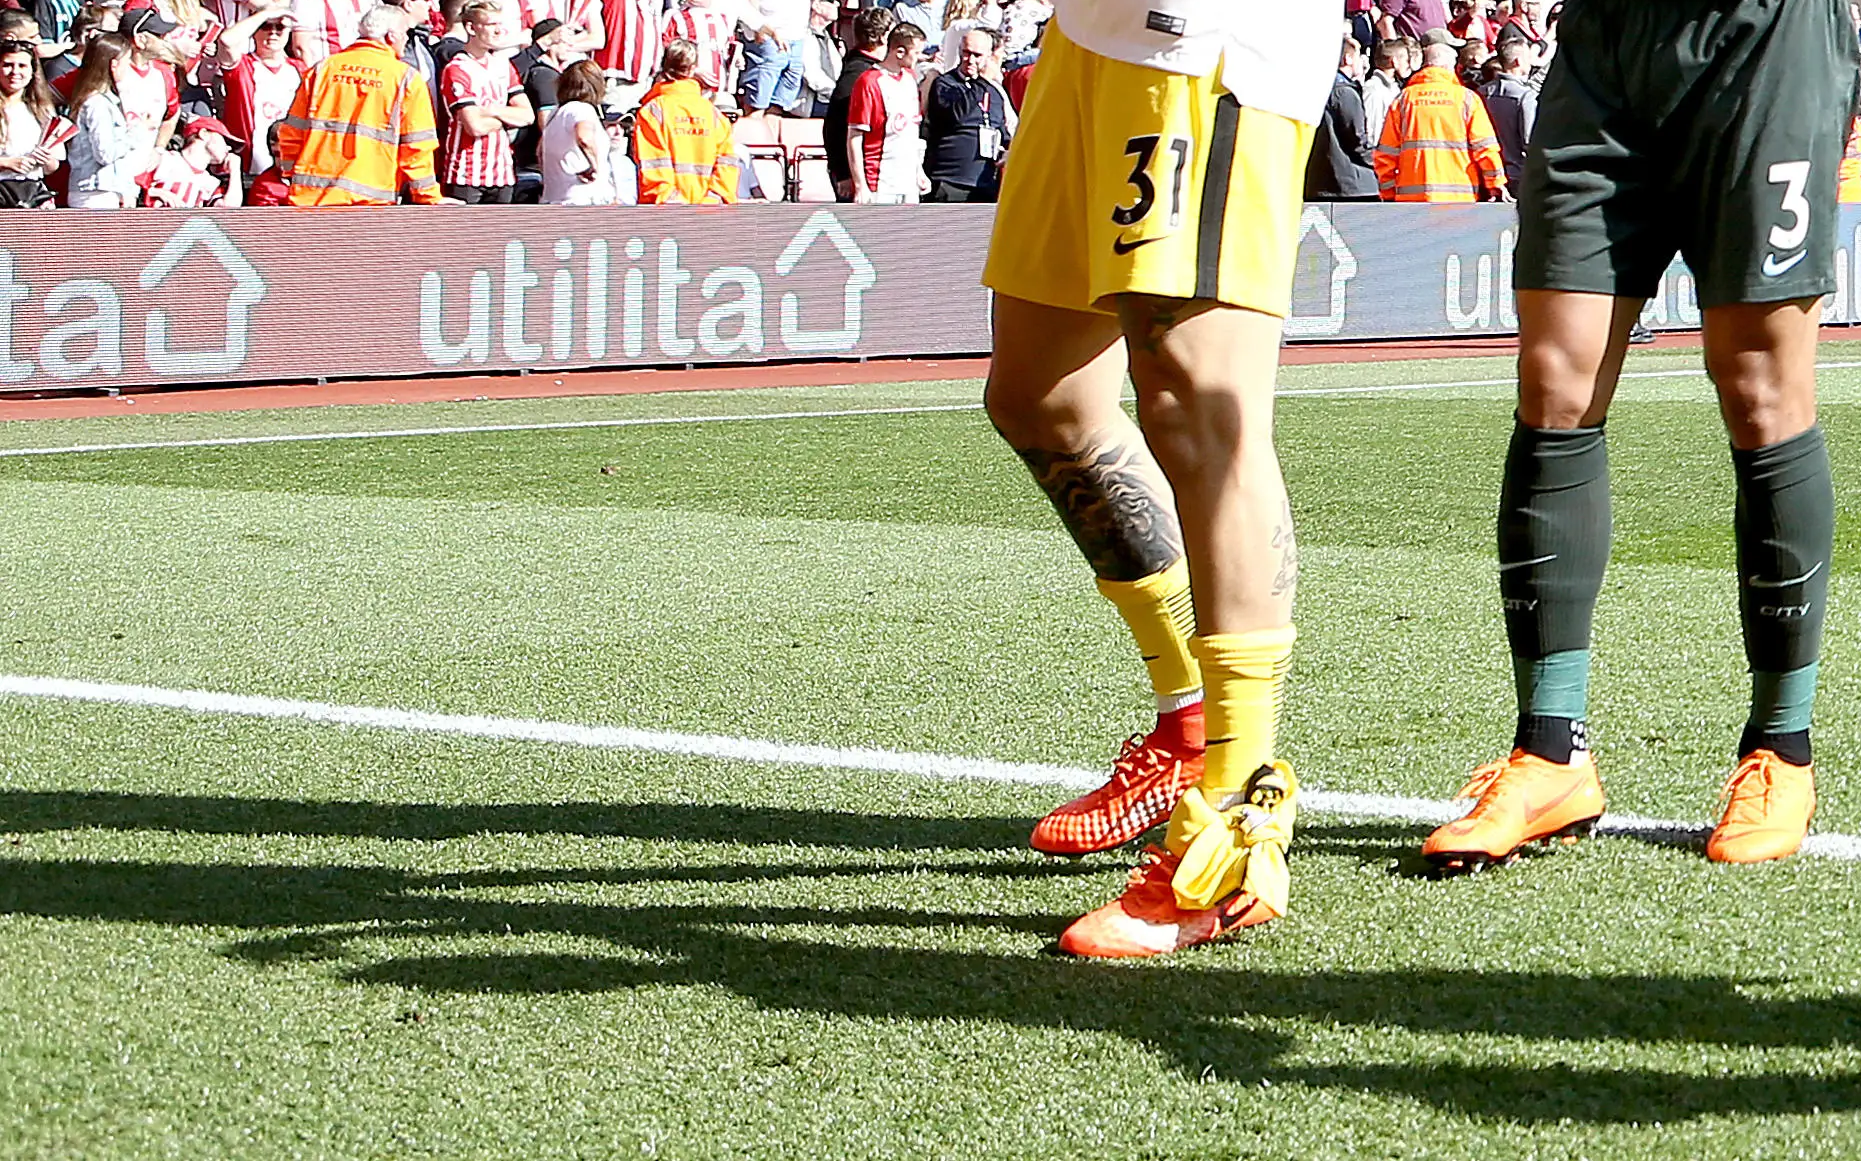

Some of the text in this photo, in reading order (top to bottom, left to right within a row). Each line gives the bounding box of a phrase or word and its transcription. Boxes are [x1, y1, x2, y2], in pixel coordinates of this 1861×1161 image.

[332, 74, 383, 89] STEWARD
[340, 64, 382, 77] SAFETY
[1111, 135, 1188, 227] 31
[1767, 160, 1811, 250] 3
[420, 238, 763, 365] utilita
[1760, 601, 1810, 617] CITY
